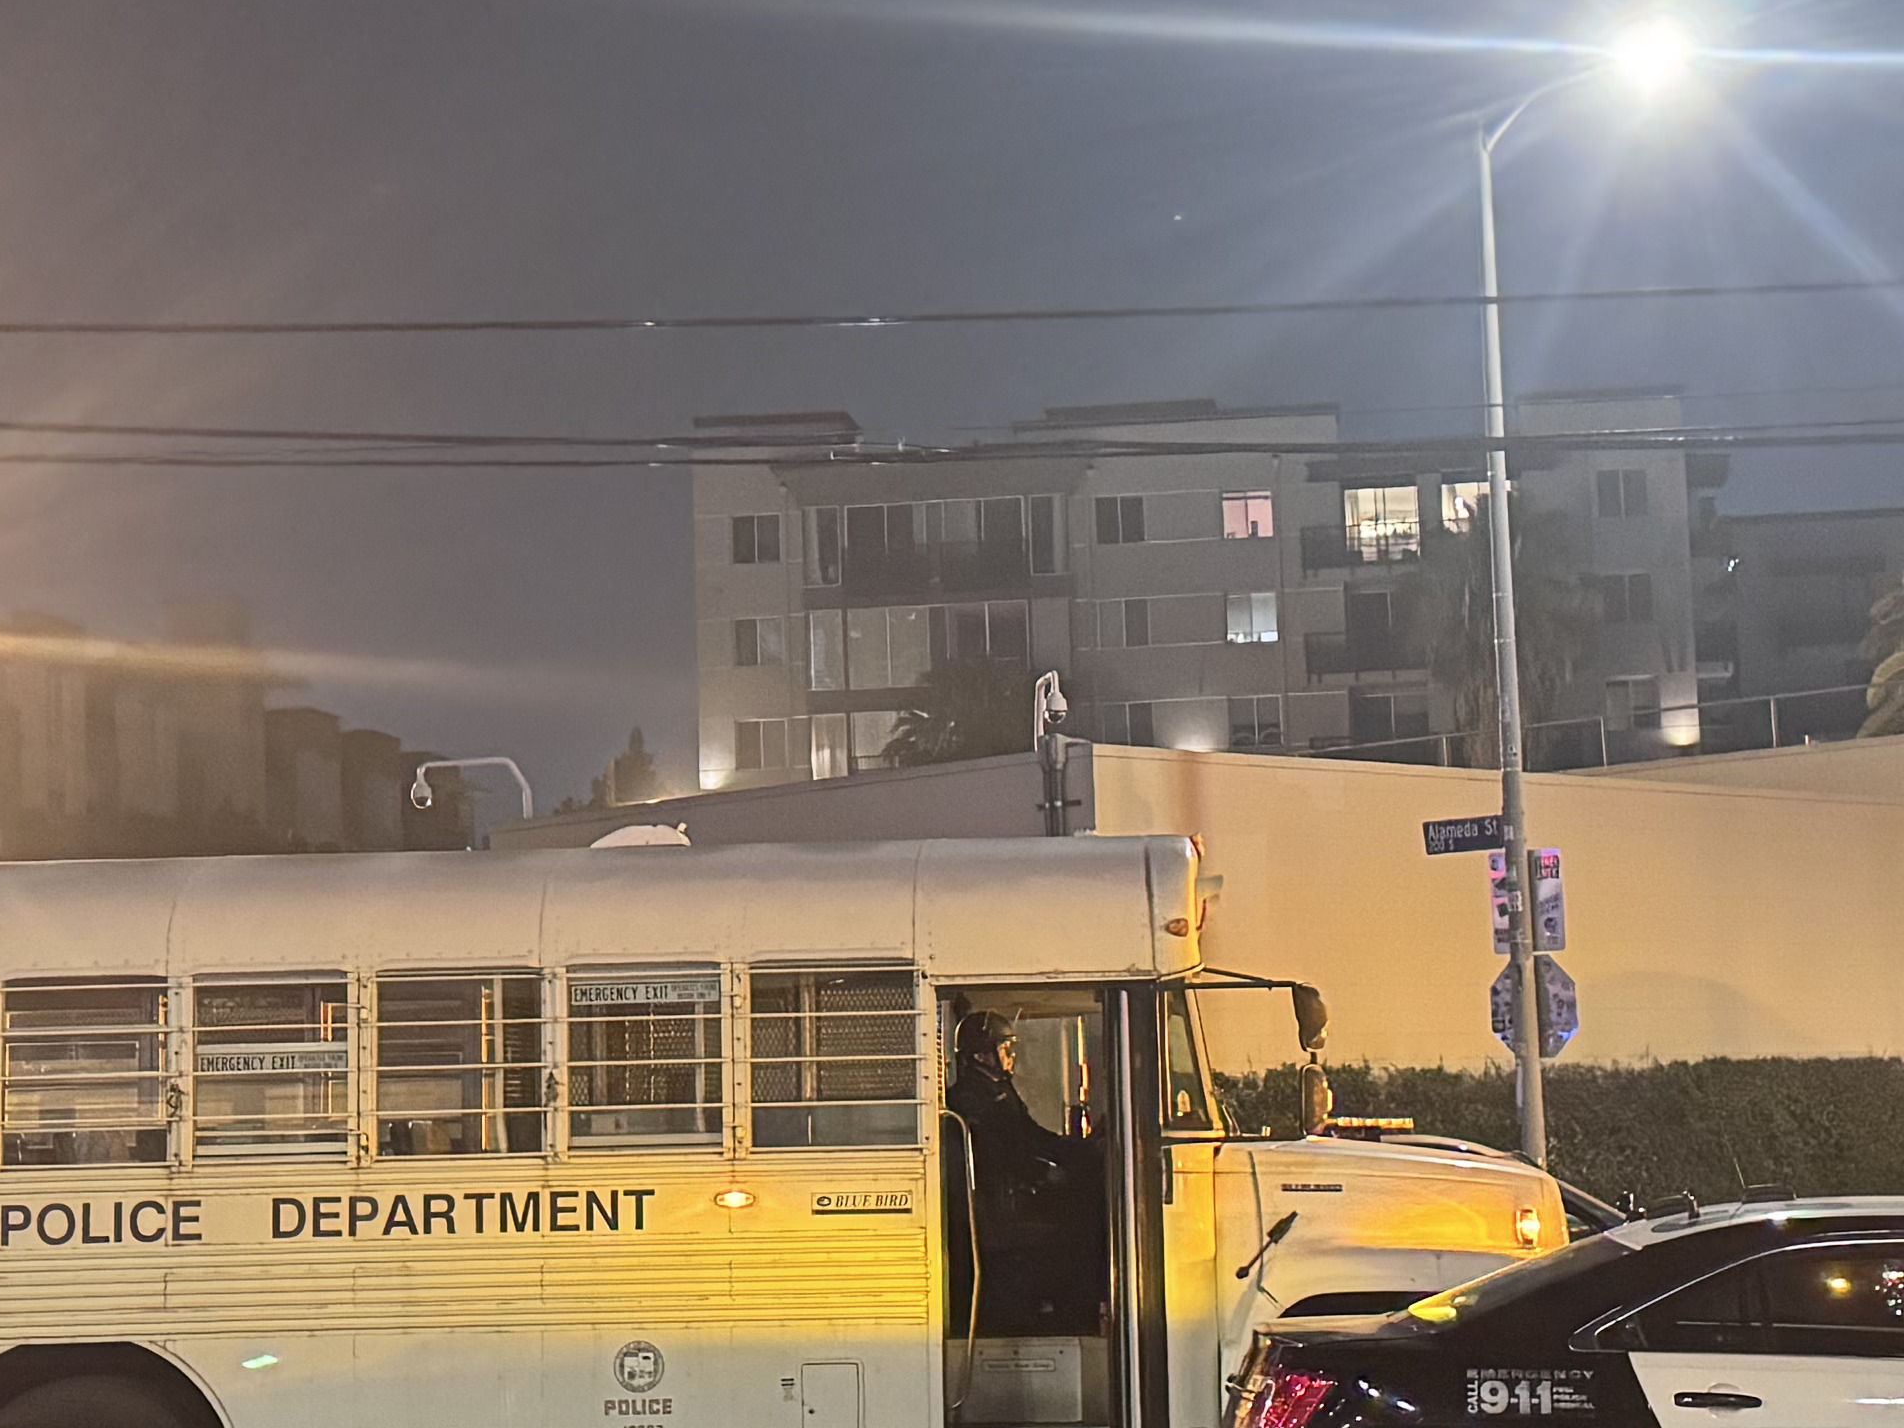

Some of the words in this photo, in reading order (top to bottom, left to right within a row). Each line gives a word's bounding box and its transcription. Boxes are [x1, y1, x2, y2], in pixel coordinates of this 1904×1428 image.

[1428, 822, 1478, 839] Alameda
[1484, 819, 1498, 836] St
[573, 986, 638, 1002] EMERGENCY
[646, 985, 668, 1000] EXIT
[200, 1056, 266, 1072] EMERGENCY
[272, 1055, 296, 1070] EXIT
[836, 1195, 872, 1208] BLUE
[876, 1194, 909, 1207] BIRD
[0, 1200, 203, 1247] POLICE
[271, 1188, 656, 1240] DEPARTMENT
[1467, 1368, 1594, 1380] EMERGENCY
[1467, 1380, 1478, 1414] CALL
[1480, 1380, 1552, 1414] 9-1-1
[604, 1398, 672, 1416] POLICE
